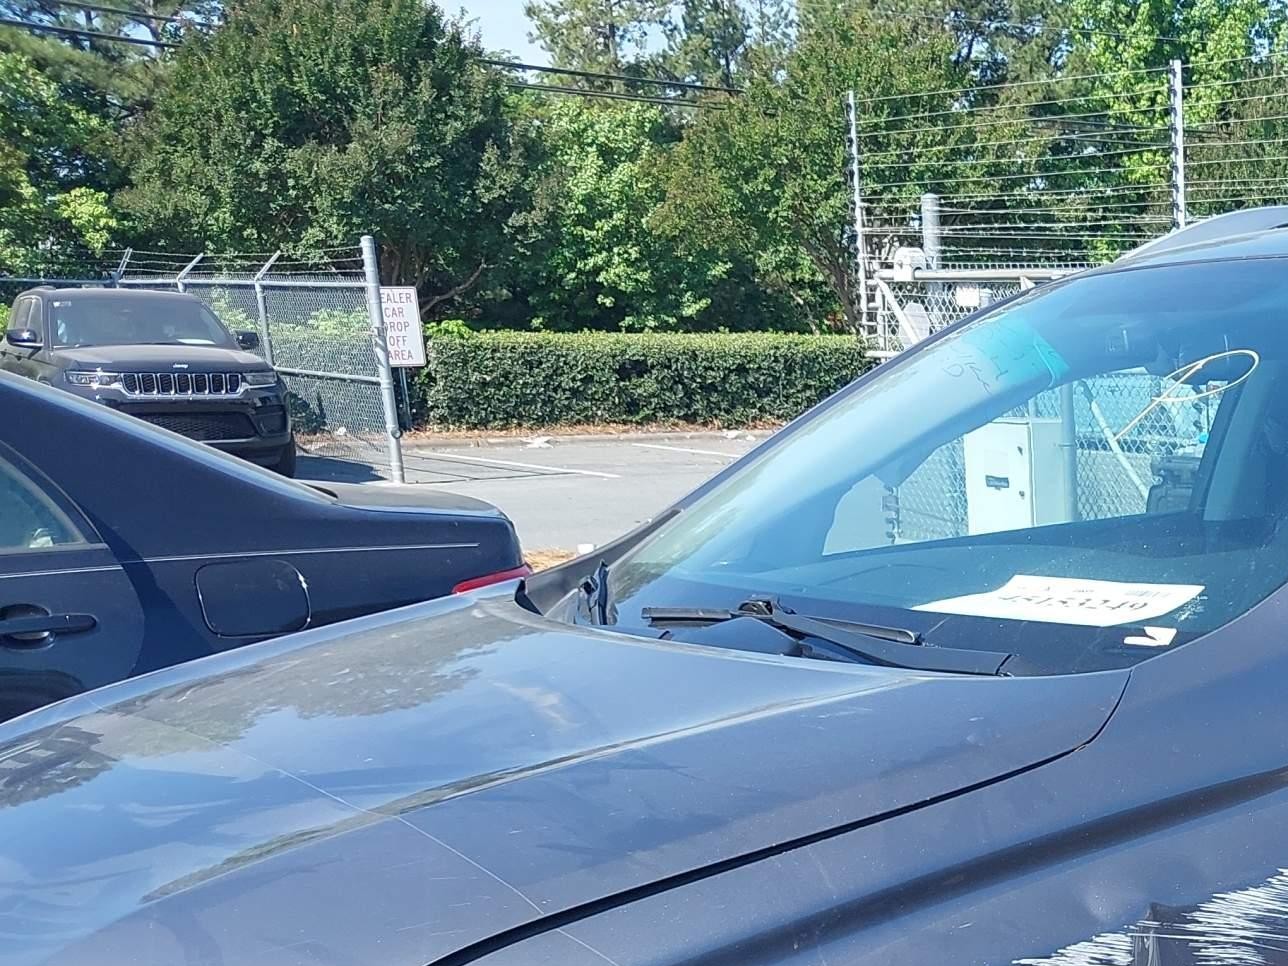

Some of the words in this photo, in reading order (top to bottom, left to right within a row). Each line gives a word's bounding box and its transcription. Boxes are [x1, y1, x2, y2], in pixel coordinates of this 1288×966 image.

[380, 292, 412, 304] EALER
[384, 306, 405, 318] CAR
[388, 335, 407, 347] OFF
[388, 349, 414, 361] AREA
